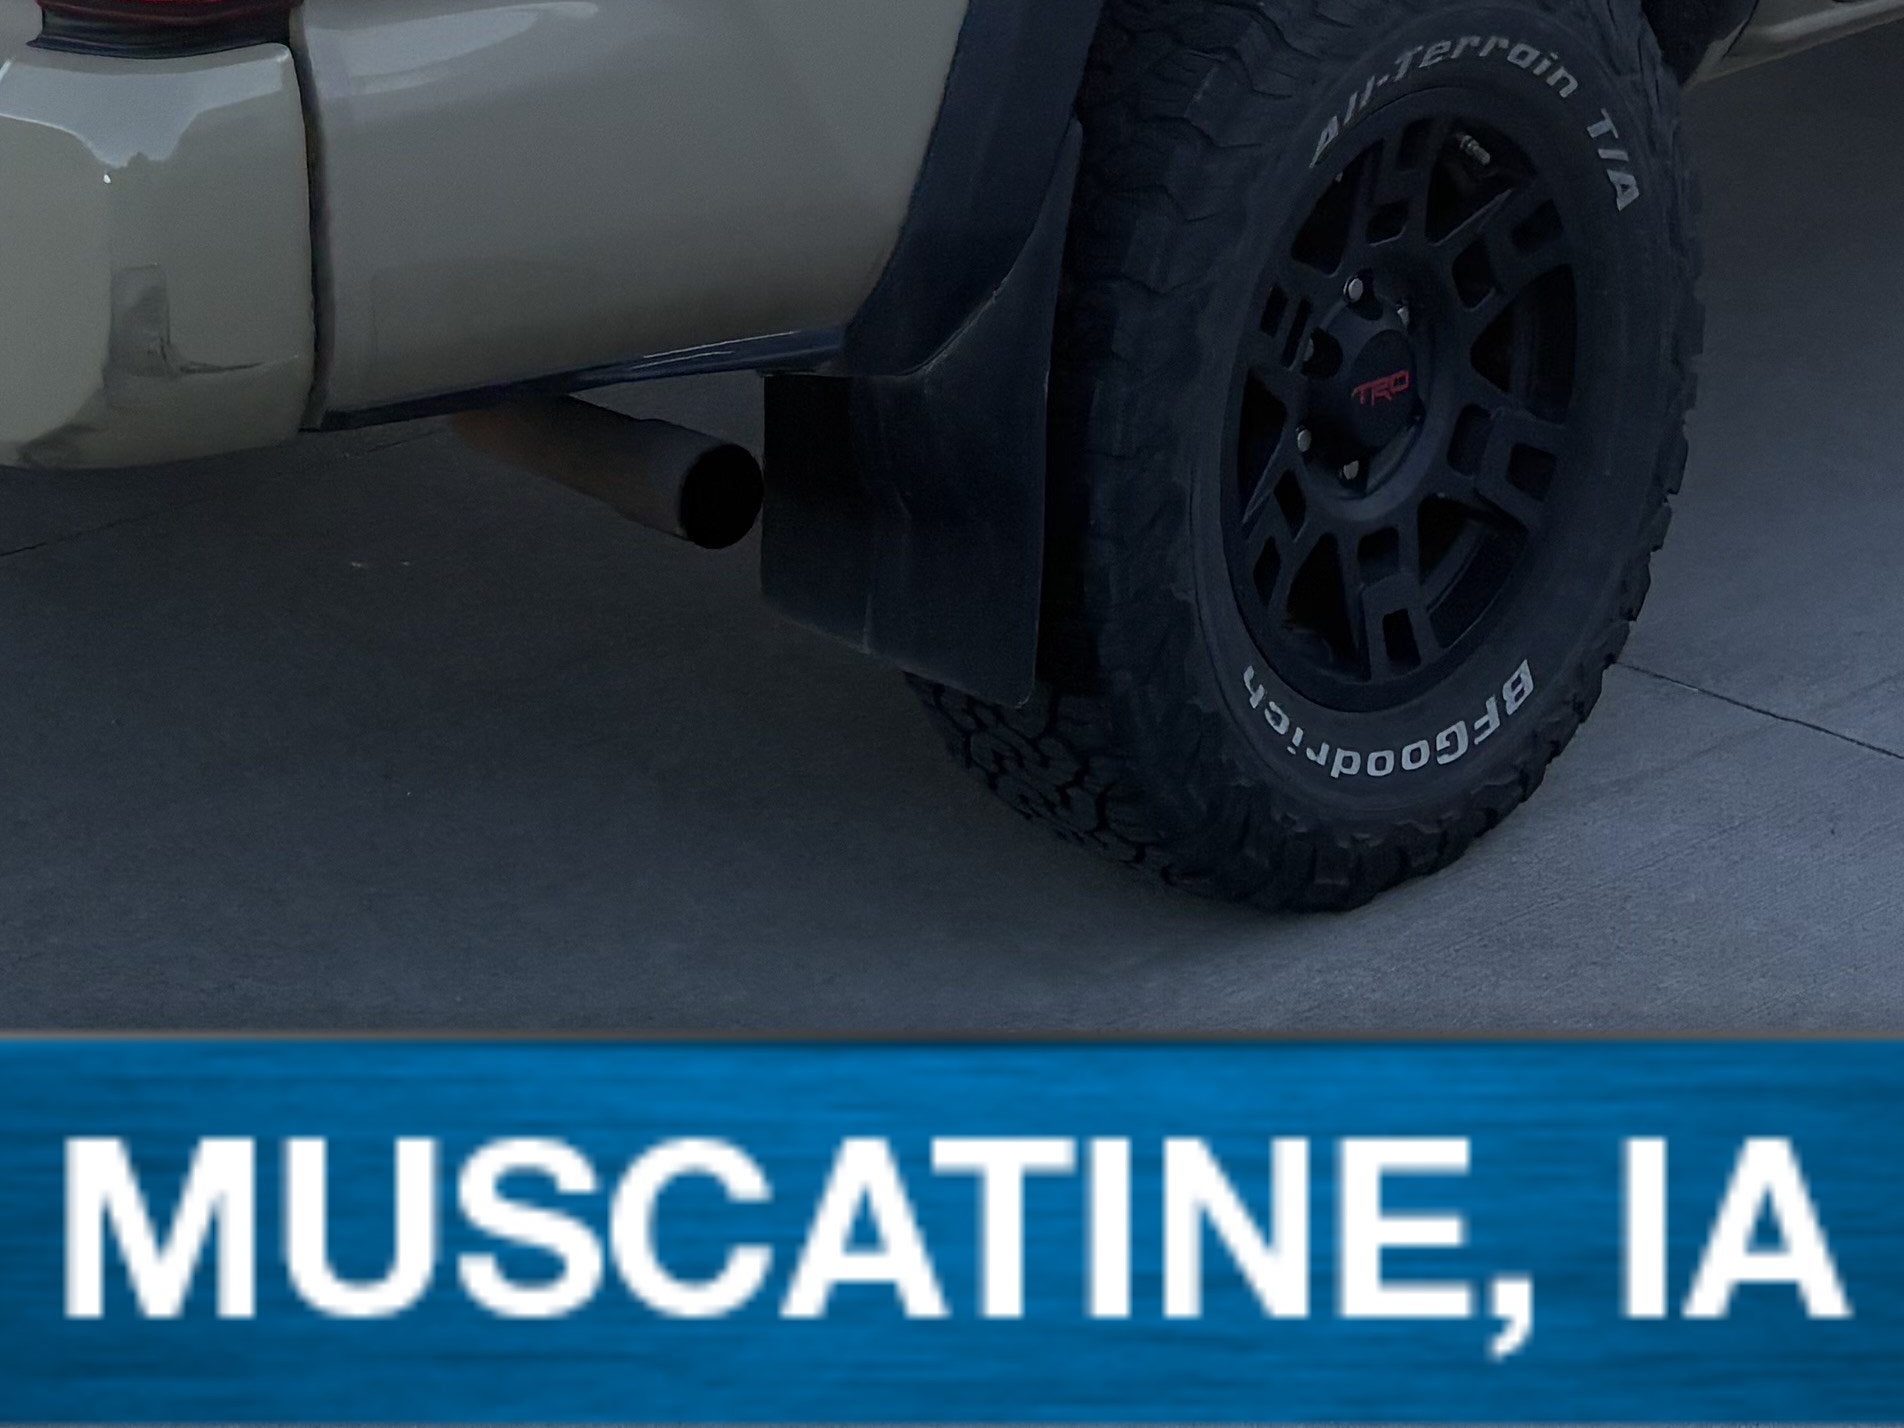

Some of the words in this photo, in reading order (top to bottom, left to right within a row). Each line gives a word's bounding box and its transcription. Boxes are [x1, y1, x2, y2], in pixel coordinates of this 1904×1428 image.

[1308, 33, 1581, 168] All-Terrain
[1350, 369, 1411, 407] TRD
[1244, 659, 1534, 779] BFGoodrich
